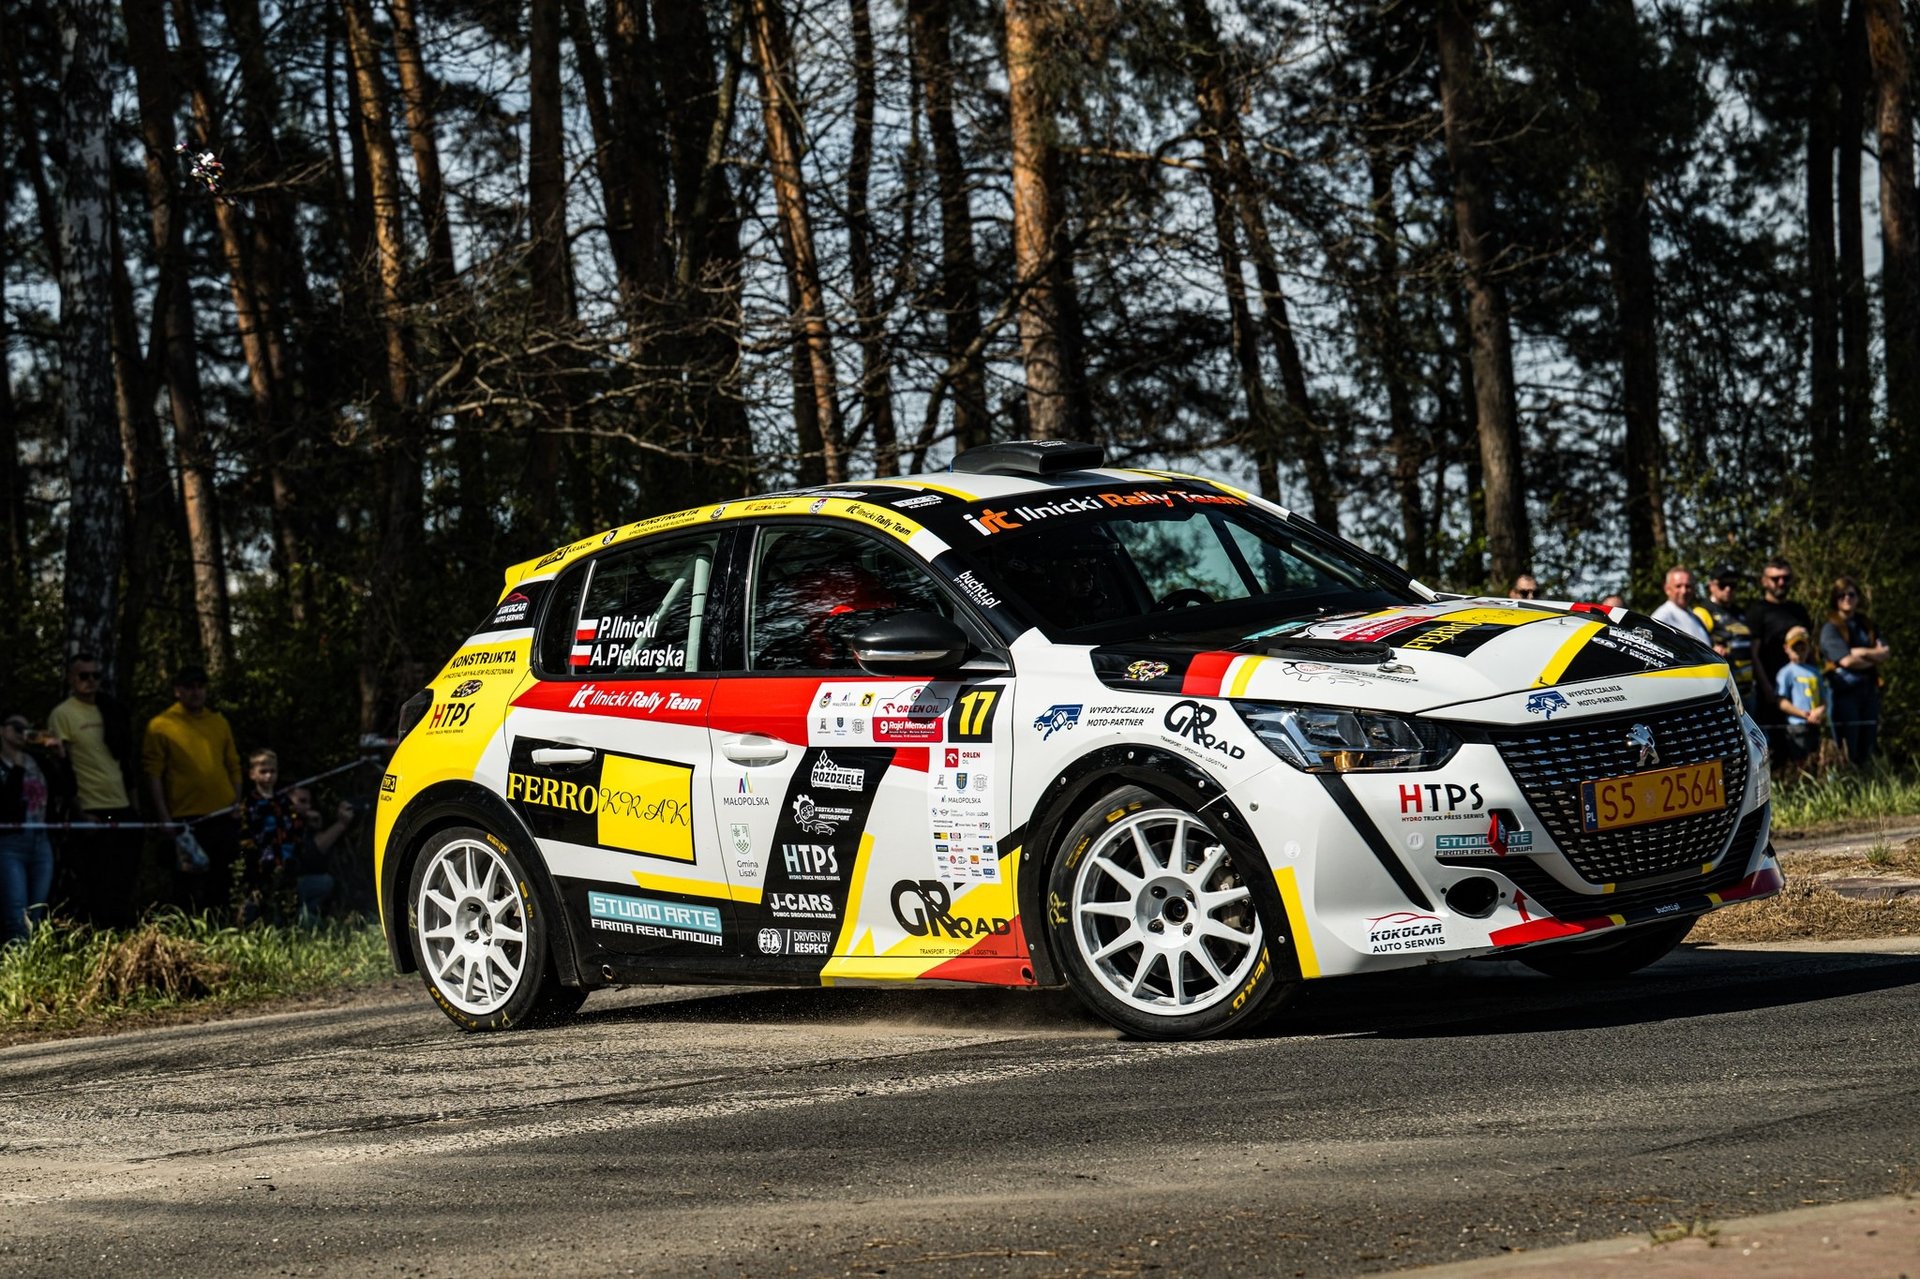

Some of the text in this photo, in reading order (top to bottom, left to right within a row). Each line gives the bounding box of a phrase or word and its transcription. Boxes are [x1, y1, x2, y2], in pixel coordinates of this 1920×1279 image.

[1014, 496, 1103, 522] Ilnicki
[1098, 492, 1174, 508] Rally
[1167, 490, 1249, 507] Team
[892, 522, 912, 536] Team
[958, 570, 1002, 609] buchti.pl
[597, 615, 659, 639] P.Ilnicki
[450, 650, 516, 669] KONSTRUKTA
[590, 644, 685, 667] A.Piekarska
[590, 690, 632, 706] Ilnicki
[627, 691, 666, 714] Rally
[665, 693, 702, 711] Team
[896, 704, 940, 714] ORLEN OIL
[1089, 704, 1155, 715] WYPOŻYCZALNIA
[429, 702, 476, 729] HTPS
[960, 691, 998, 735] 17
[1086, 718, 1145, 727] MOTO-PARTNER
[880, 720, 889, 734] 9
[889, 720, 904, 730] Rajd
[812, 771, 863, 786] ROZDZIELE
[507, 772, 598, 815] FERRO
[723, 797, 770, 806] MAŁOPOLSKA
[1398, 783, 1484, 813] HTPS
[1602, 767, 1719, 822] S5 2564
[1401, 814, 1422, 822] HYDRO
[1586, 811, 1596, 823] PL
[737, 860, 759, 869] Gmina
[782, 844, 838, 874] HTPS
[739, 869, 757, 877] Liszki
[770, 893, 834, 912] J-CARS
[593, 897, 717, 928] STUDIO ARTE
[592, 919, 723, 947] FIRMA REKLAMOWA
[793, 931, 832, 943] DRIVEN BY
[1370, 923, 1443, 942] KOKOCAR
[794, 942, 828, 954] RESPECT
[1372, 937, 1446, 954] AUTO SERWIS
